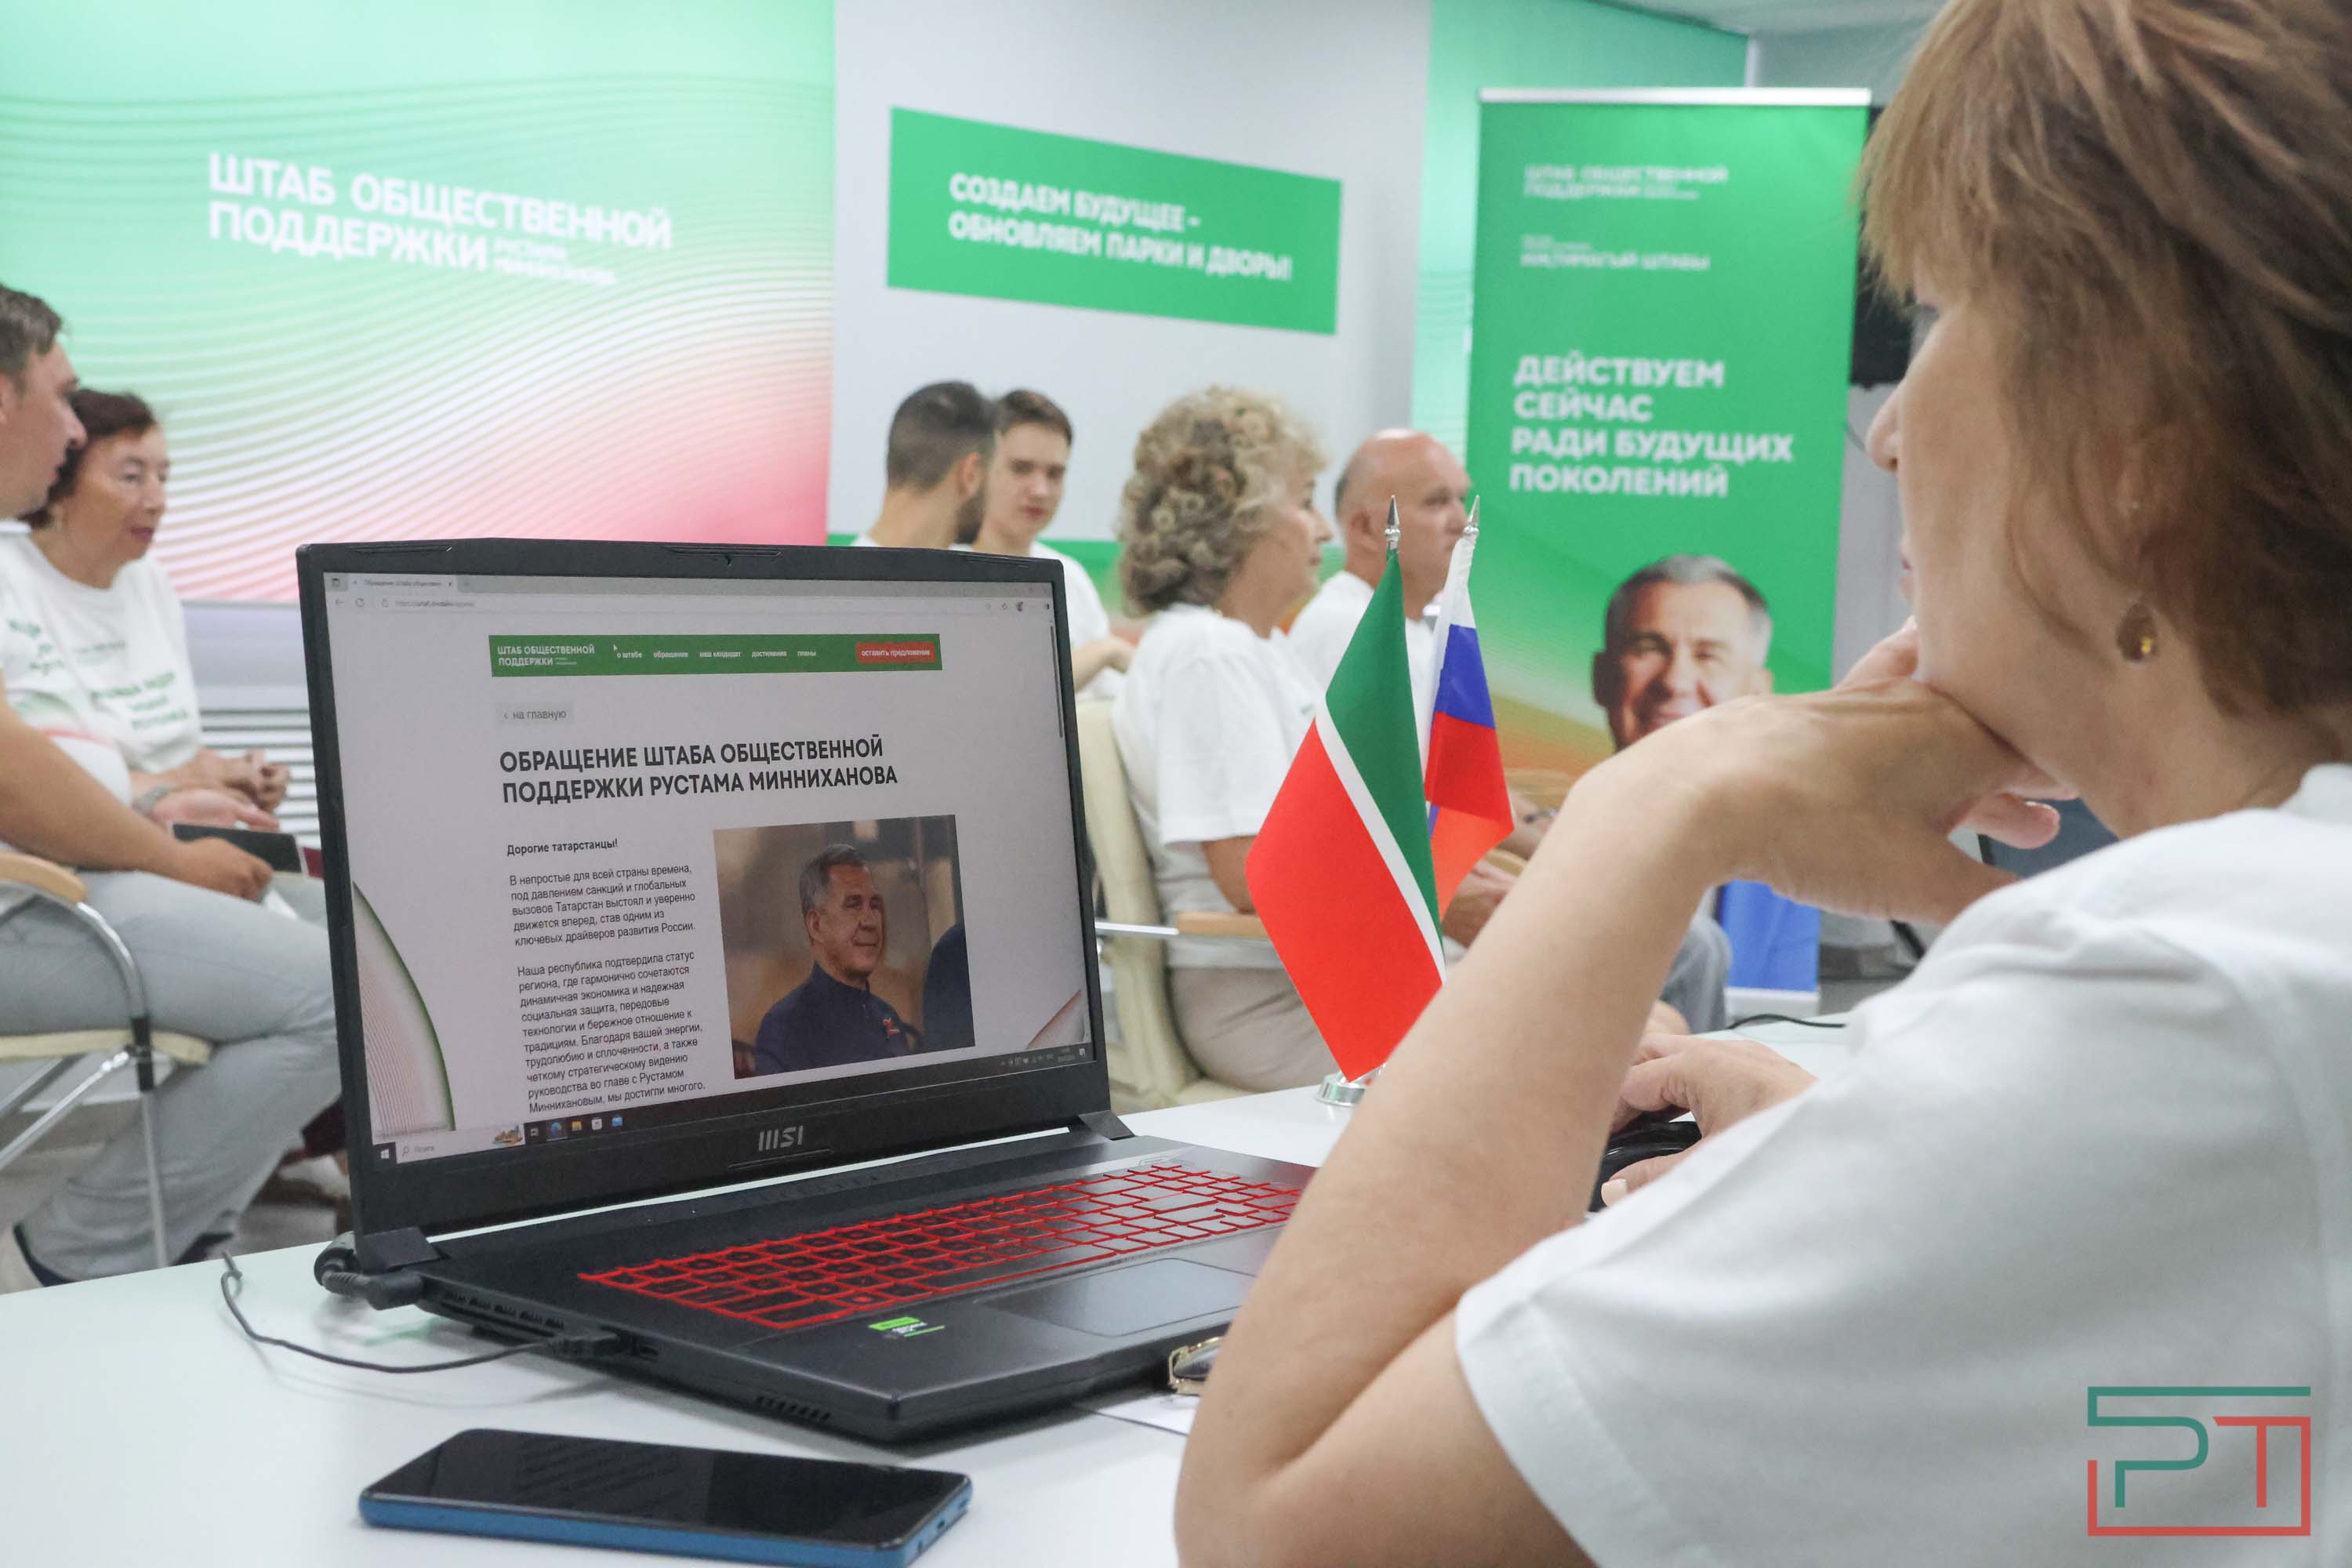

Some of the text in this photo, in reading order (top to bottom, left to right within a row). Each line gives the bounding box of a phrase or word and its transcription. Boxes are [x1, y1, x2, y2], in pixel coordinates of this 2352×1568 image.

[209, 152, 673, 250] ШТАБ ОБЩЕСТВЕННОЙ
[949, 172, 1070, 217] СОЗДАЕМ
[1074, 191, 1185, 233] БУДУЩЕЕ
[209, 201, 489, 270] ПОДДЕРЖКИ
[949, 211, 1292, 281] ОБНОВЛЯЕМ ПАРКИ И ДВОРЫ!
[1513, 350, 1724, 387] ДЕЙСТВУЕМ
[1514, 387, 1653, 422] СЕЙЧАС
[1512, 427, 1794, 465] РАДИ БУДУЩИХ
[1509, 463, 1728, 497] ПОКОЛЕНИЙ
[498, 644, 595, 655] ШТАБ ОБЩЕСТВЕННОЙ
[499, 657, 554, 666] ПОДДЕРЖКИ
[513, 709, 566, 722] на главную
[500, 735, 884, 772] ОБРАЩЕНИЕ ШТАБА ОБЩЕСТВЕННОЙ
[503, 766, 898, 805] ПОДДЕРЖКИ РУСТАМА МИННИХАНОВА
[507, 838, 618, 856] Дорогие татарстанцы!
[510, 865, 691, 887] В непростые для всей страны времена,
[511, 891, 528, 902] под
[532, 887, 583, 900] давлением
[586, 883, 623, 896] санкций
[633, 879, 686, 891] глобальных
[512, 905, 553, 916] вызовов
[556, 901, 604, 913] Татарстан
[606, 898, 643, 908] выстоял
[654, 892, 695, 906] уверенно
[514, 910, 665, 932] движется вперед, став одним из
[515, 922, 695, 946] ключевых драйверов развития России.
[517, 951, 695, 976] Наша республика подтвердила статус
[519, 966, 689, 993] региона, где гармонично сочетаются
[520, 981, 684, 1008] динамичная экономика и надежная
[521, 997, 670, 1023] социальная защита, передовые
[523, 1023, 576, 1037] технологии
[579, 1022, 585, 1031] и
[587, 1016, 633, 1030] бережное
[635, 1012, 684, 1024] отношение
[524, 1023, 702, 1054] традициям. Благодаря вашей энергии,
[525, 1052, 584, 1069] трудолюбию
[595, 1043, 661, 1059] сплоченности,
[671, 1039, 698, 1048] также
[527, 1054, 688, 1083] четкому стратегическому видению
[528, 1083, 587, 1099] руководства
[590, 1081, 601, 1090] во
[604, 1076, 630, 1087] главе
[639, 1069, 684, 1083] Рустамом
[529, 1082, 706, 1113] Миннихановым, мы достигли многого.
[758, 1125, 804, 1151] MSI
